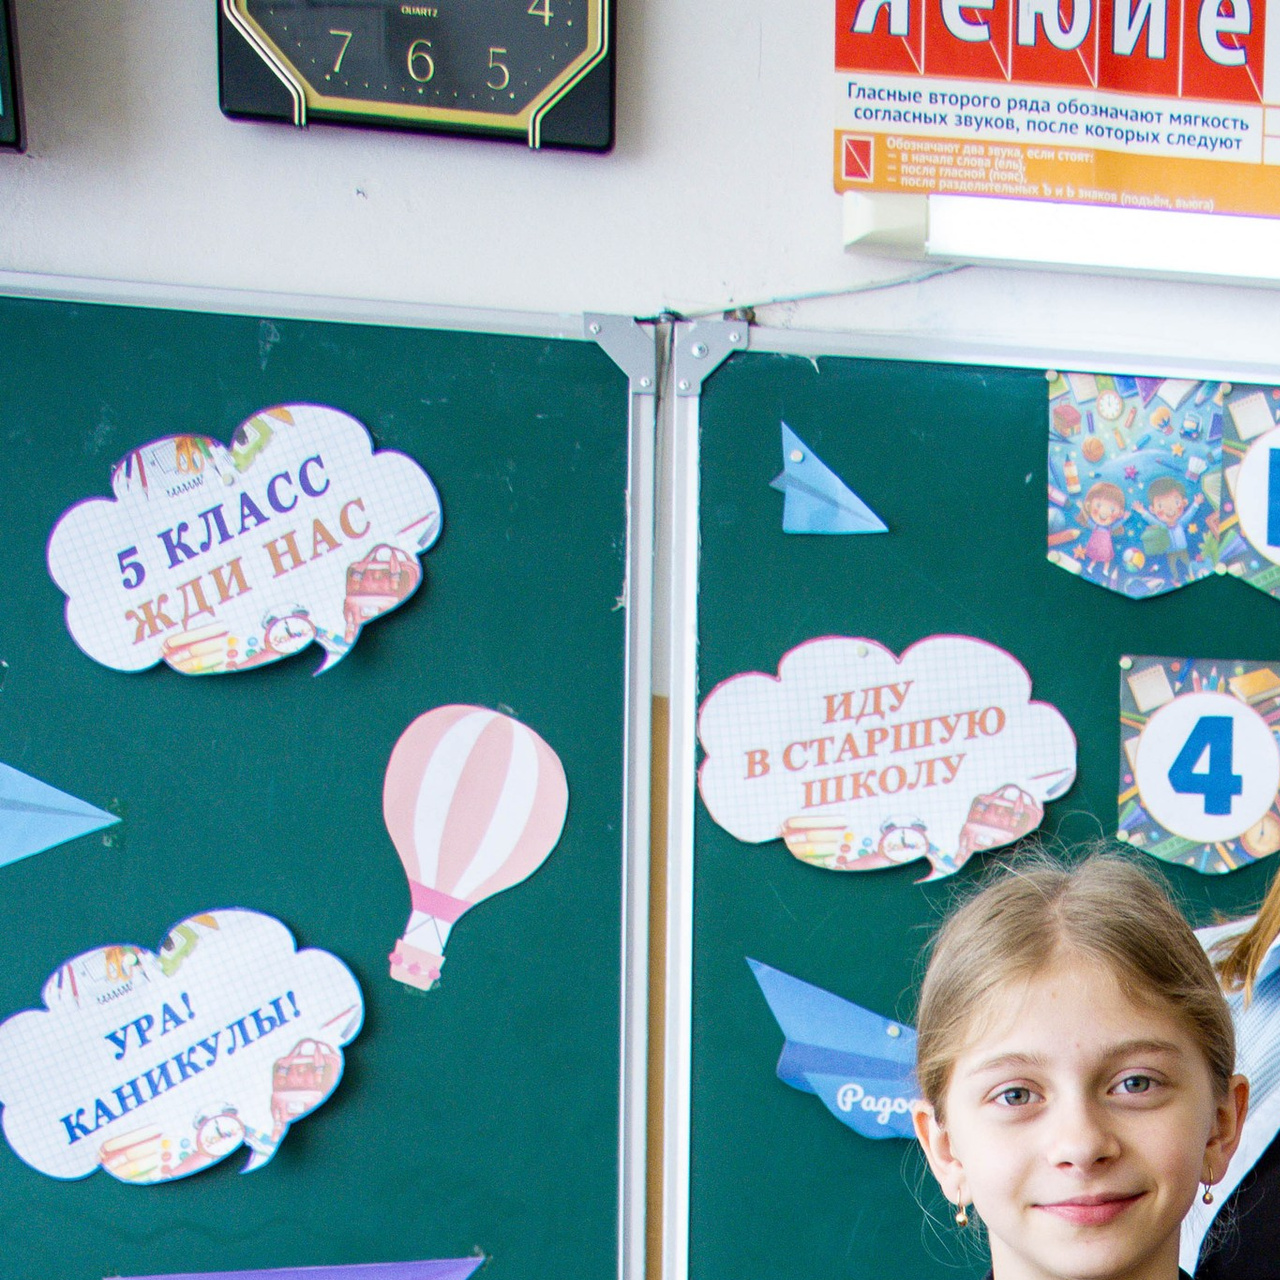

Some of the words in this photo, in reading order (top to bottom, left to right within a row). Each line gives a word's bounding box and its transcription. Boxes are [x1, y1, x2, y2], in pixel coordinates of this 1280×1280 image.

[401, 5, 438, 17] QUARTZ
[329, 29, 353, 73] 7
[407, 39, 435, 82] 6
[487, 47, 510, 89] 5
[848, 82, 922, 104] Гласные
[929, 92, 1001, 110] второго
[1007, 98, 1050, 115] ряда
[1057, 101, 1164, 124] обозначают
[1169, 112, 1250, 132] мягкость
[854, 107, 948, 126] согласных
[954, 113, 1020, 134] звуков,
[1026, 119, 1078, 135] после
[1085, 123, 1160, 147] которых
[1166, 134, 1243, 152] следуют
[886, 136, 960, 153] Обозначают
[964, 143, 985, 156] два
[988, 145, 1023, 159] звука,
[1027, 150, 1055, 161] если
[1058, 152, 1094, 163] стоят:
[912, 154, 953, 166] начале
[956, 156, 991, 168] слова
[901, 166, 936, 177] после
[939, 168, 986, 180] гласной
[901, 177, 936, 189] после
[939, 178, 1038, 196] разделительных
[1078, 190, 1117, 202] знаков
[116, 547, 146, 591] 5
[157, 455, 333, 569] КЛАСС
[125, 556, 253, 645] ЖДИ
[263, 497, 372, 581] НАС
[822, 680, 914, 725] ИДУ
[744, 749, 770, 780] В
[782, 705, 1007, 773] СТАРШУЮ
[801, 752, 967, 810] ШКОЛУ
[104, 992, 198, 1062] УРА!
[58, 990, 303, 1146] КАНИКУЛЫ!
